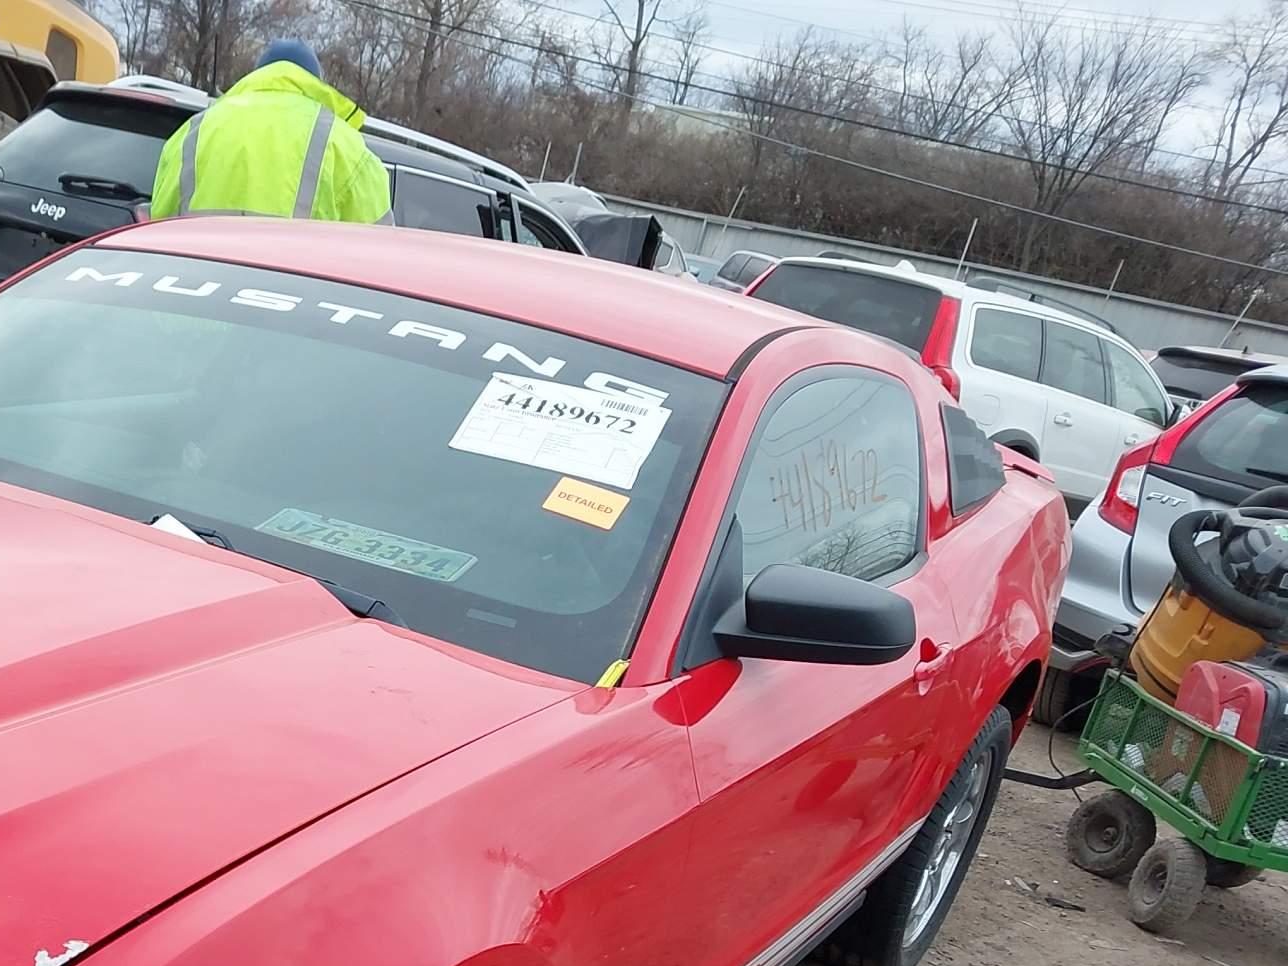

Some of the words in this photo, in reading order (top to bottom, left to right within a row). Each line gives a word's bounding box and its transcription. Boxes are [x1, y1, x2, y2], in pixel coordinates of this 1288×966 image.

[31, 198, 66, 221] Jeep
[65, 267, 671, 407] MUSTANG
[497, 392, 637, 434] 44189672
[558, 491, 613, 514] DETAILED
[1146, 491, 1187, 507] FIT
